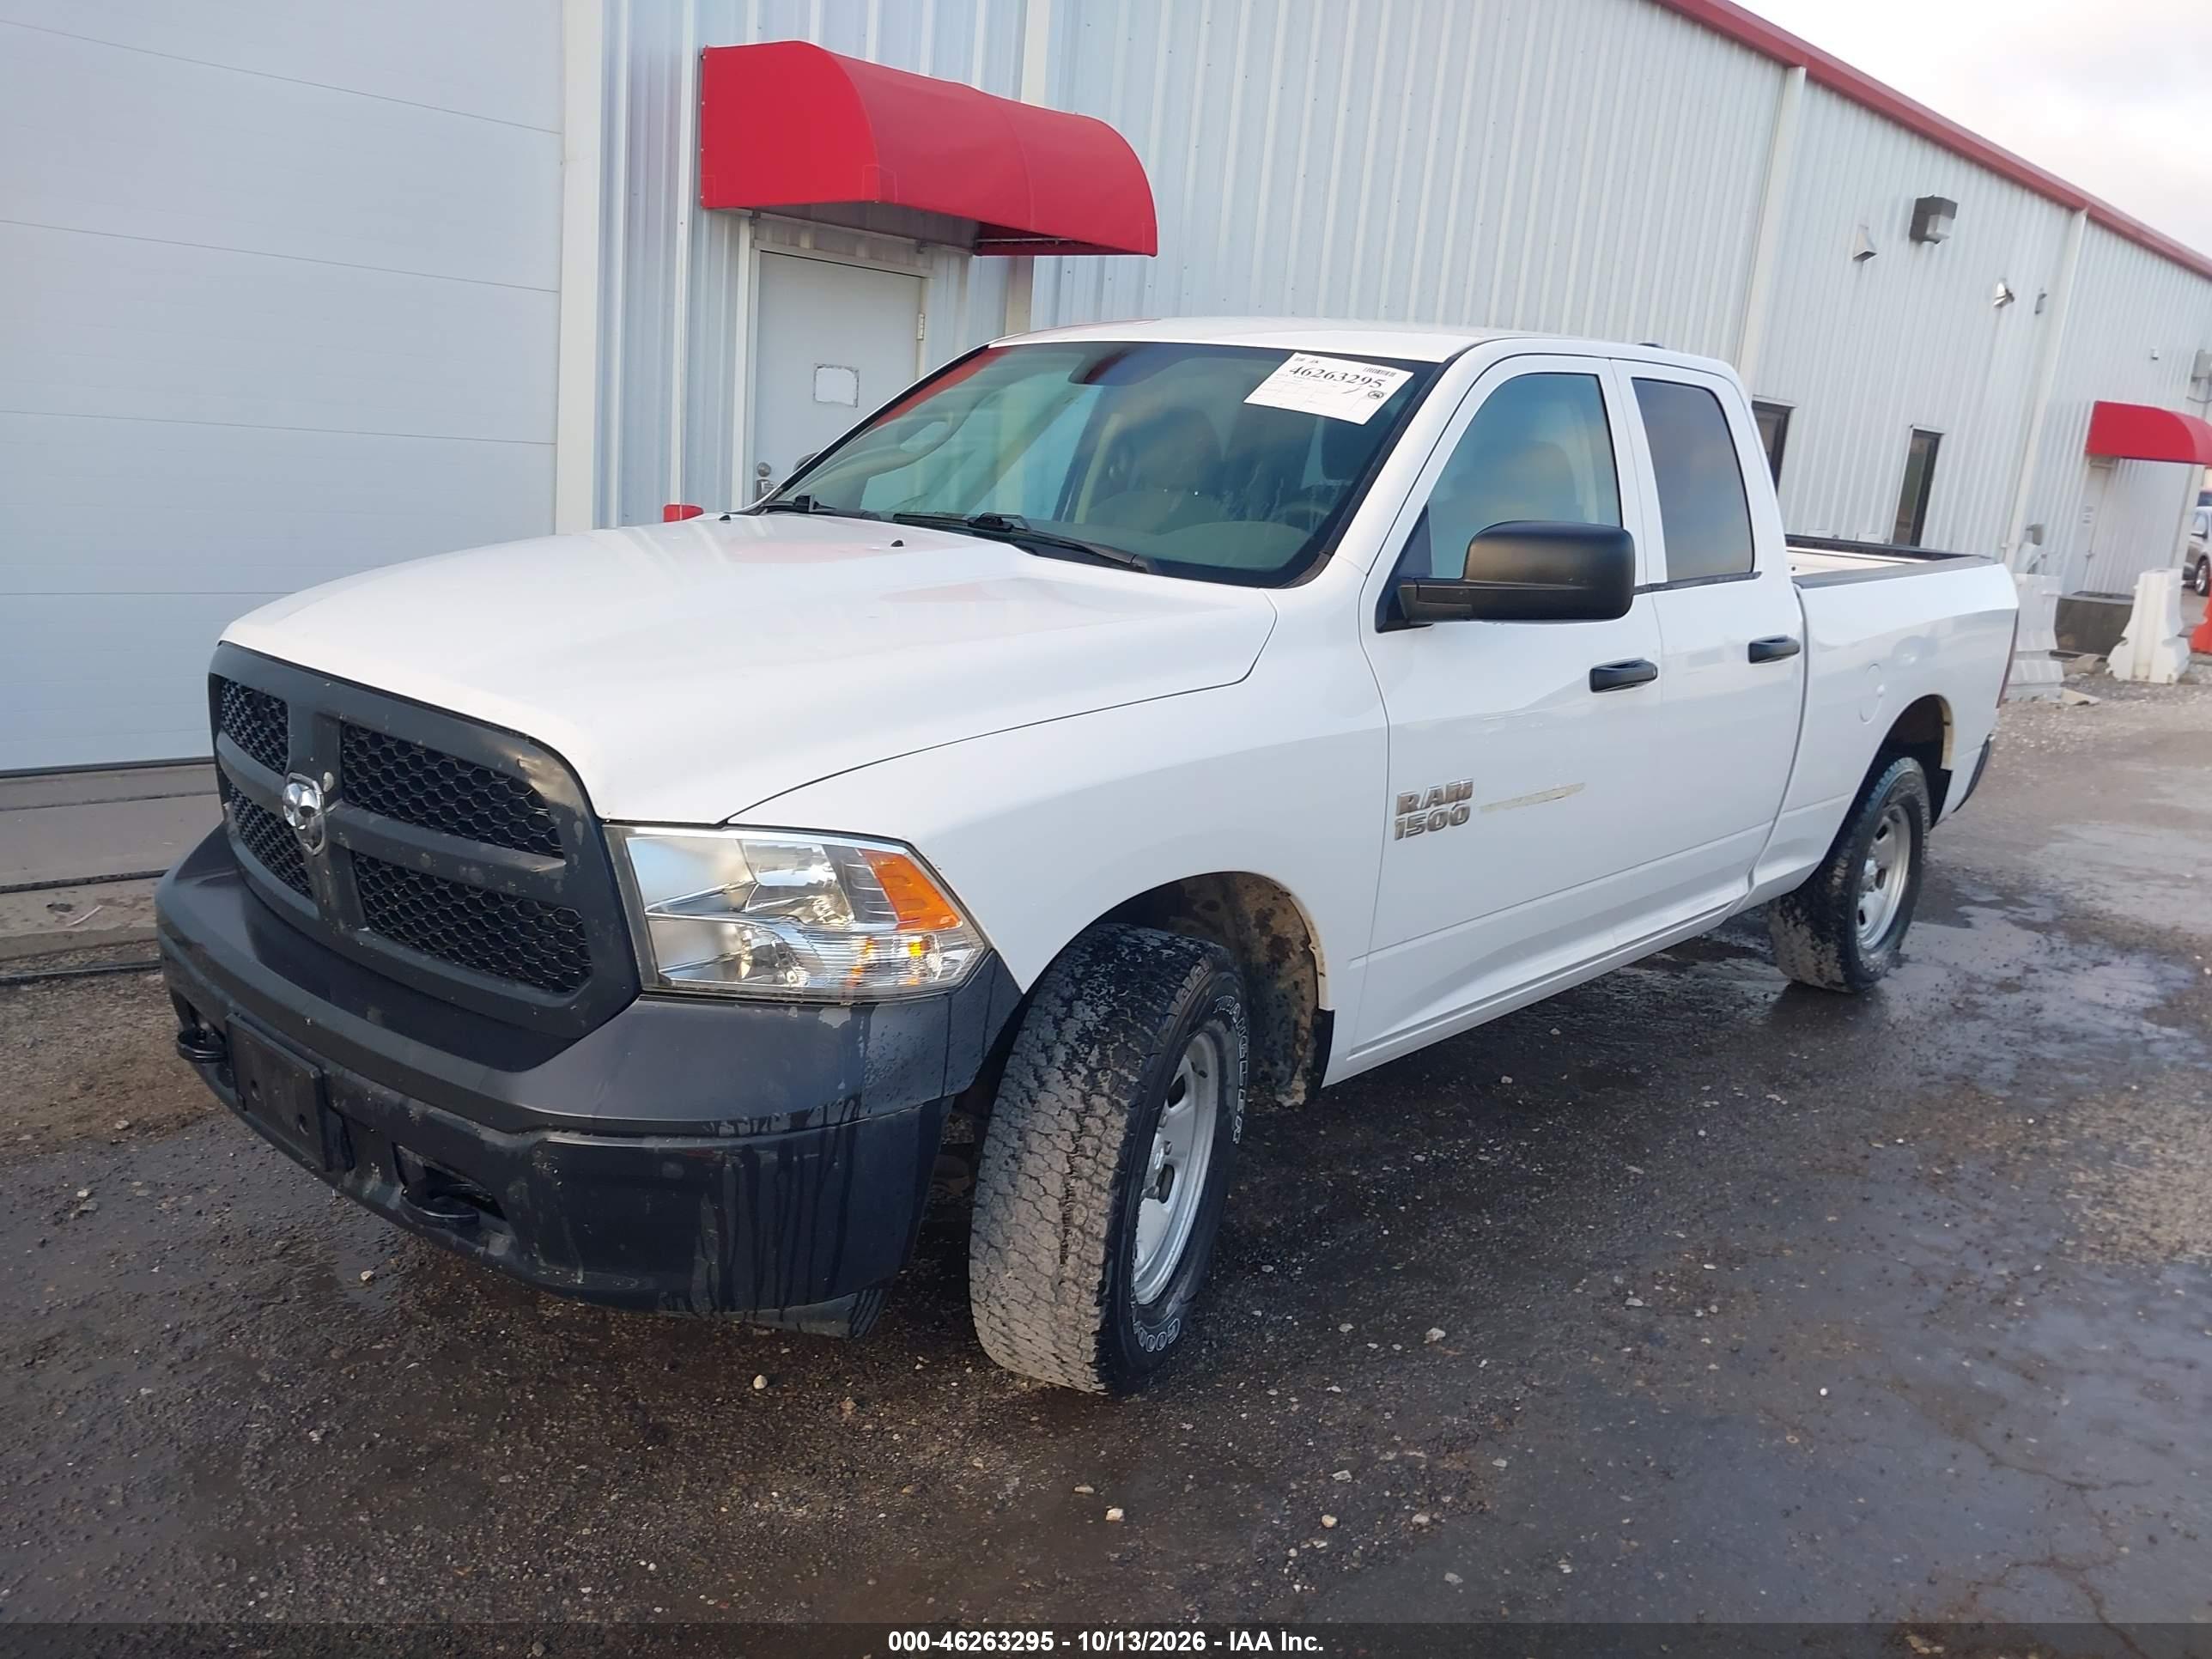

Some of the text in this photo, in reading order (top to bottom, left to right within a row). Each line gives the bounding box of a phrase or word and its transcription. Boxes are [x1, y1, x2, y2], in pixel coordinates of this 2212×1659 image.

[1289, 364, 1388, 389] 46263295
[1395, 777, 1474, 817] RAM
[1394, 802, 1471, 842] 1500
[1212, 994, 1249, 1144] RANGLER
